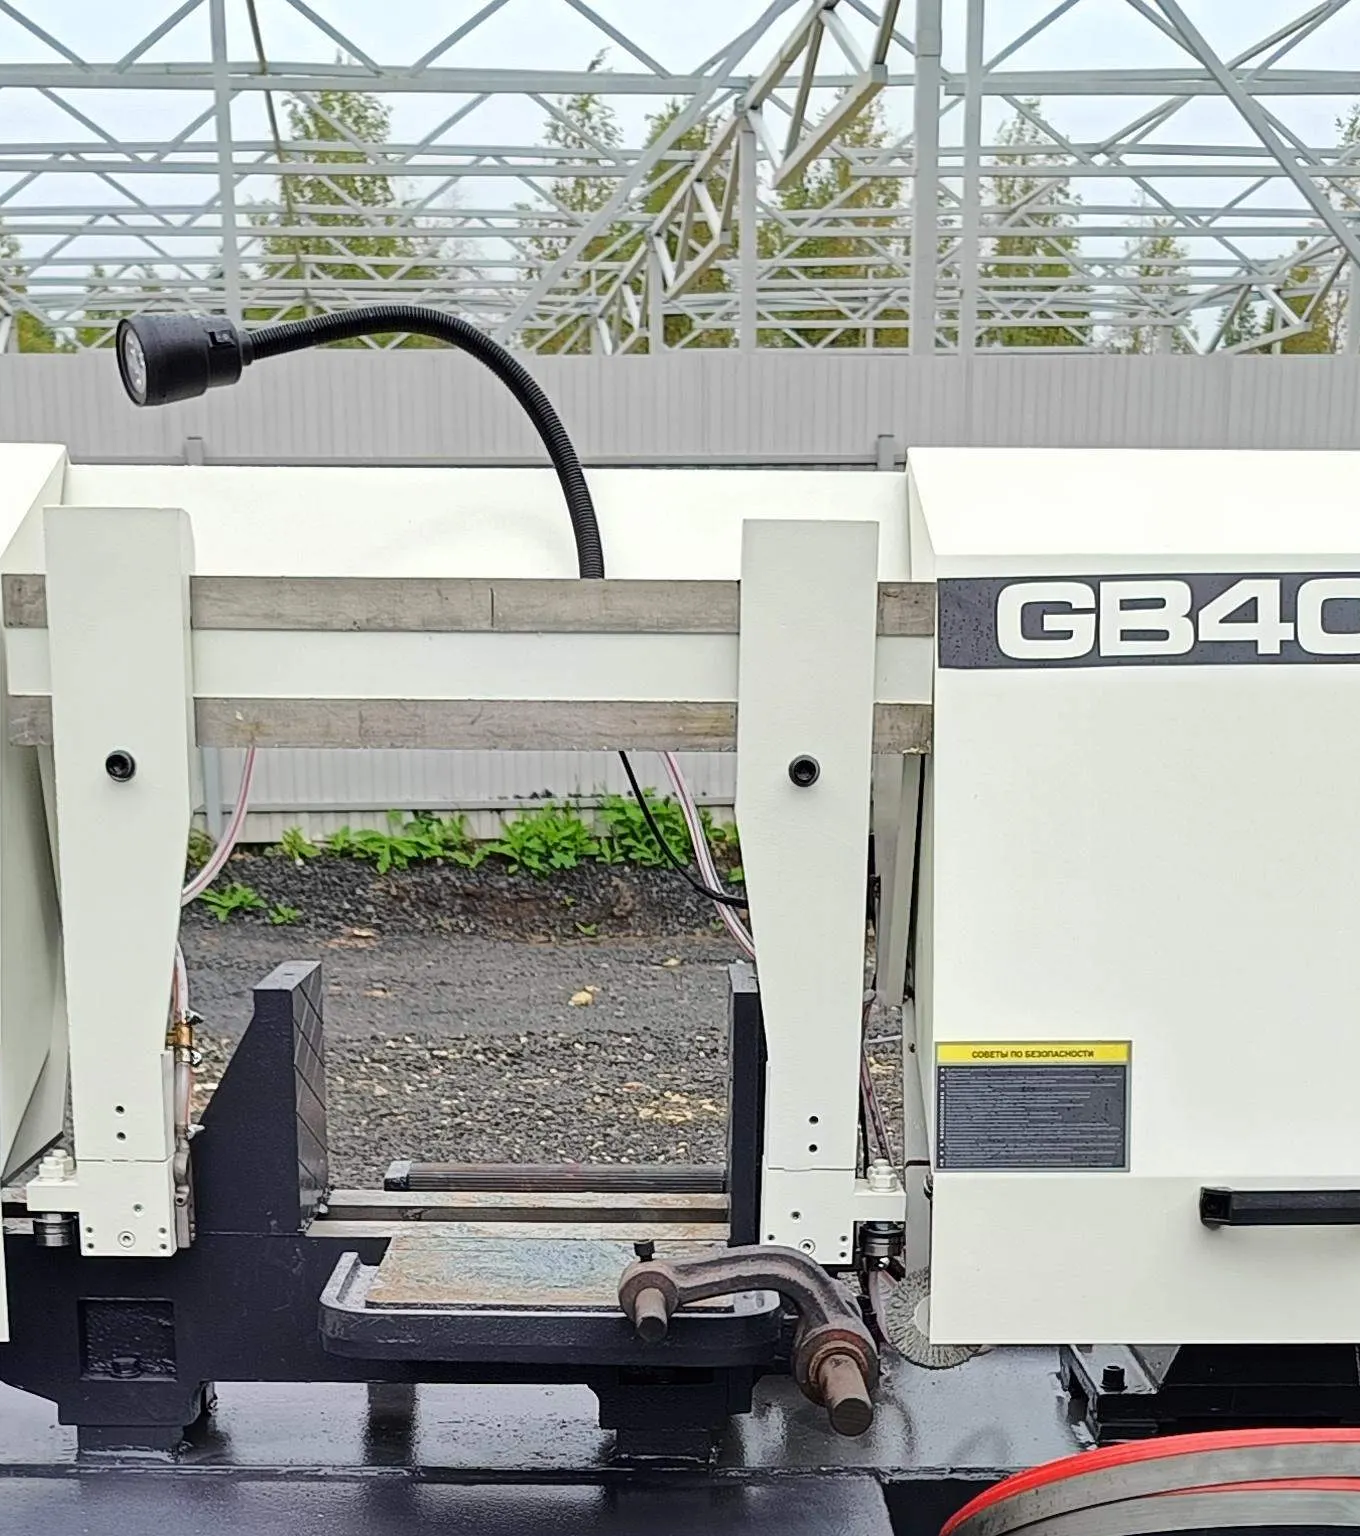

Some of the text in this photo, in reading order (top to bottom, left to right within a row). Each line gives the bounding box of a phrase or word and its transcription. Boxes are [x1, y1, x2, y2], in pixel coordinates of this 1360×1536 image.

[971, 1049, 1095, 1059] СОВЕТЫ ПО БЕЗОПАСНОСТИ
